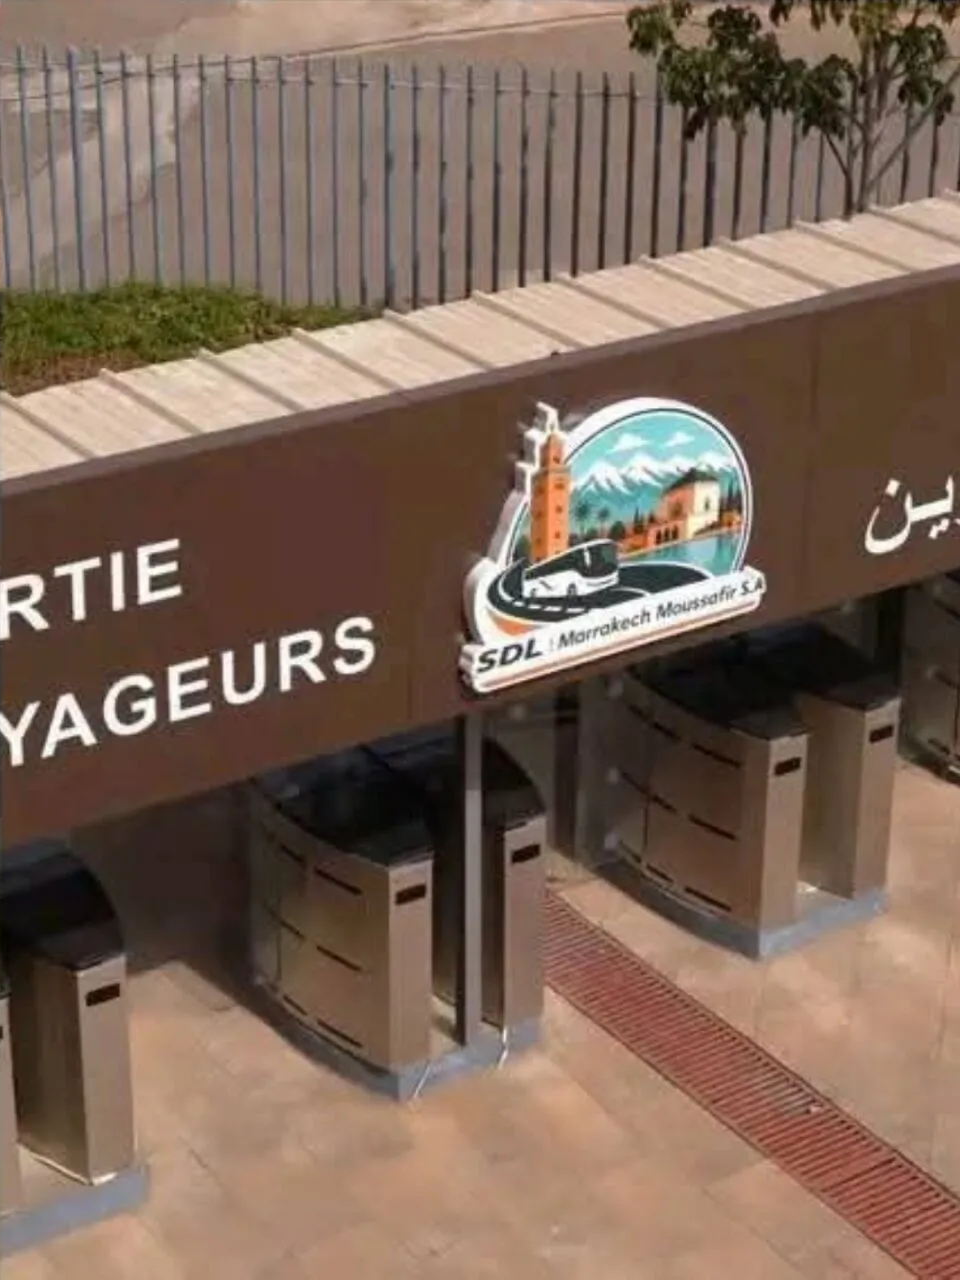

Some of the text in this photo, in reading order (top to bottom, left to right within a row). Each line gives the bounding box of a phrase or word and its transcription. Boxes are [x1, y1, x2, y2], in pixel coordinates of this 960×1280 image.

[0, 538, 183, 641] RTIE
[476, 638, 543, 673] SDL
[557, 609, 652, 649] Marrakech
[656, 585, 737, 621] Moussafir
[0, 616, 377, 767] YAGEURS
